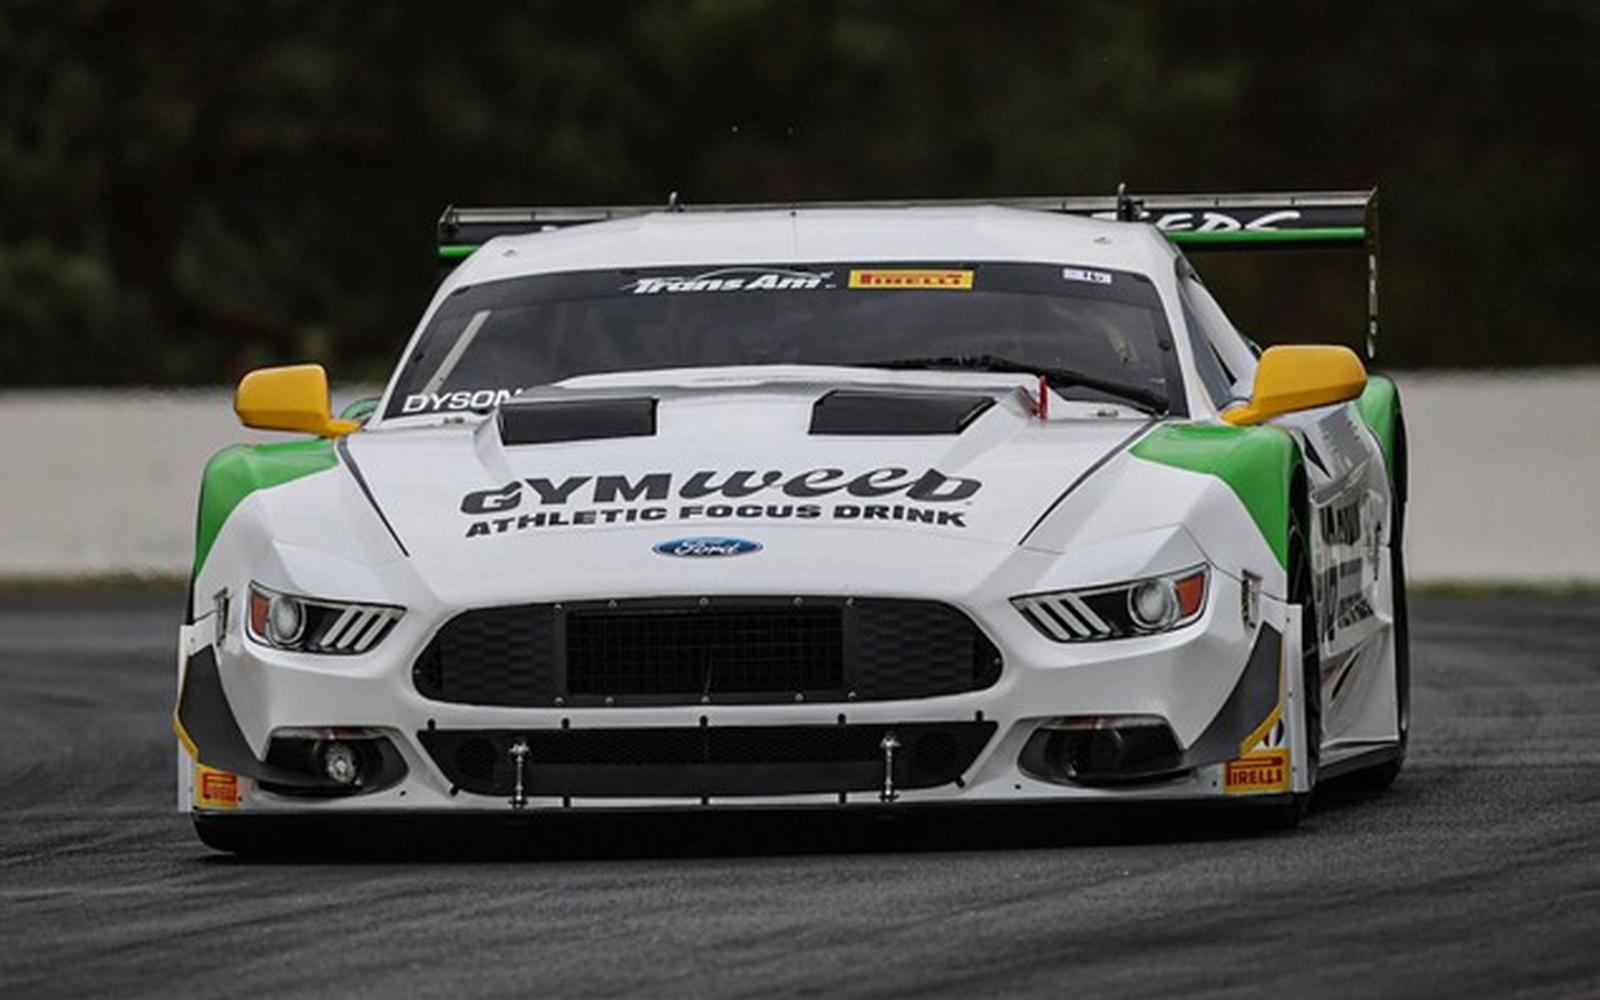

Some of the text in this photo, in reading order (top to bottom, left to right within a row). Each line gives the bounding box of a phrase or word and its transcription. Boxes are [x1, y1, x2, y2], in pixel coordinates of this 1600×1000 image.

[633, 277, 746, 294] Trans
[401, 388, 522, 413] DYSON
[465, 504, 966, 538] ATHLETIC FOCUS DRINK
[1225, 756, 1284, 787] PIRELLI
